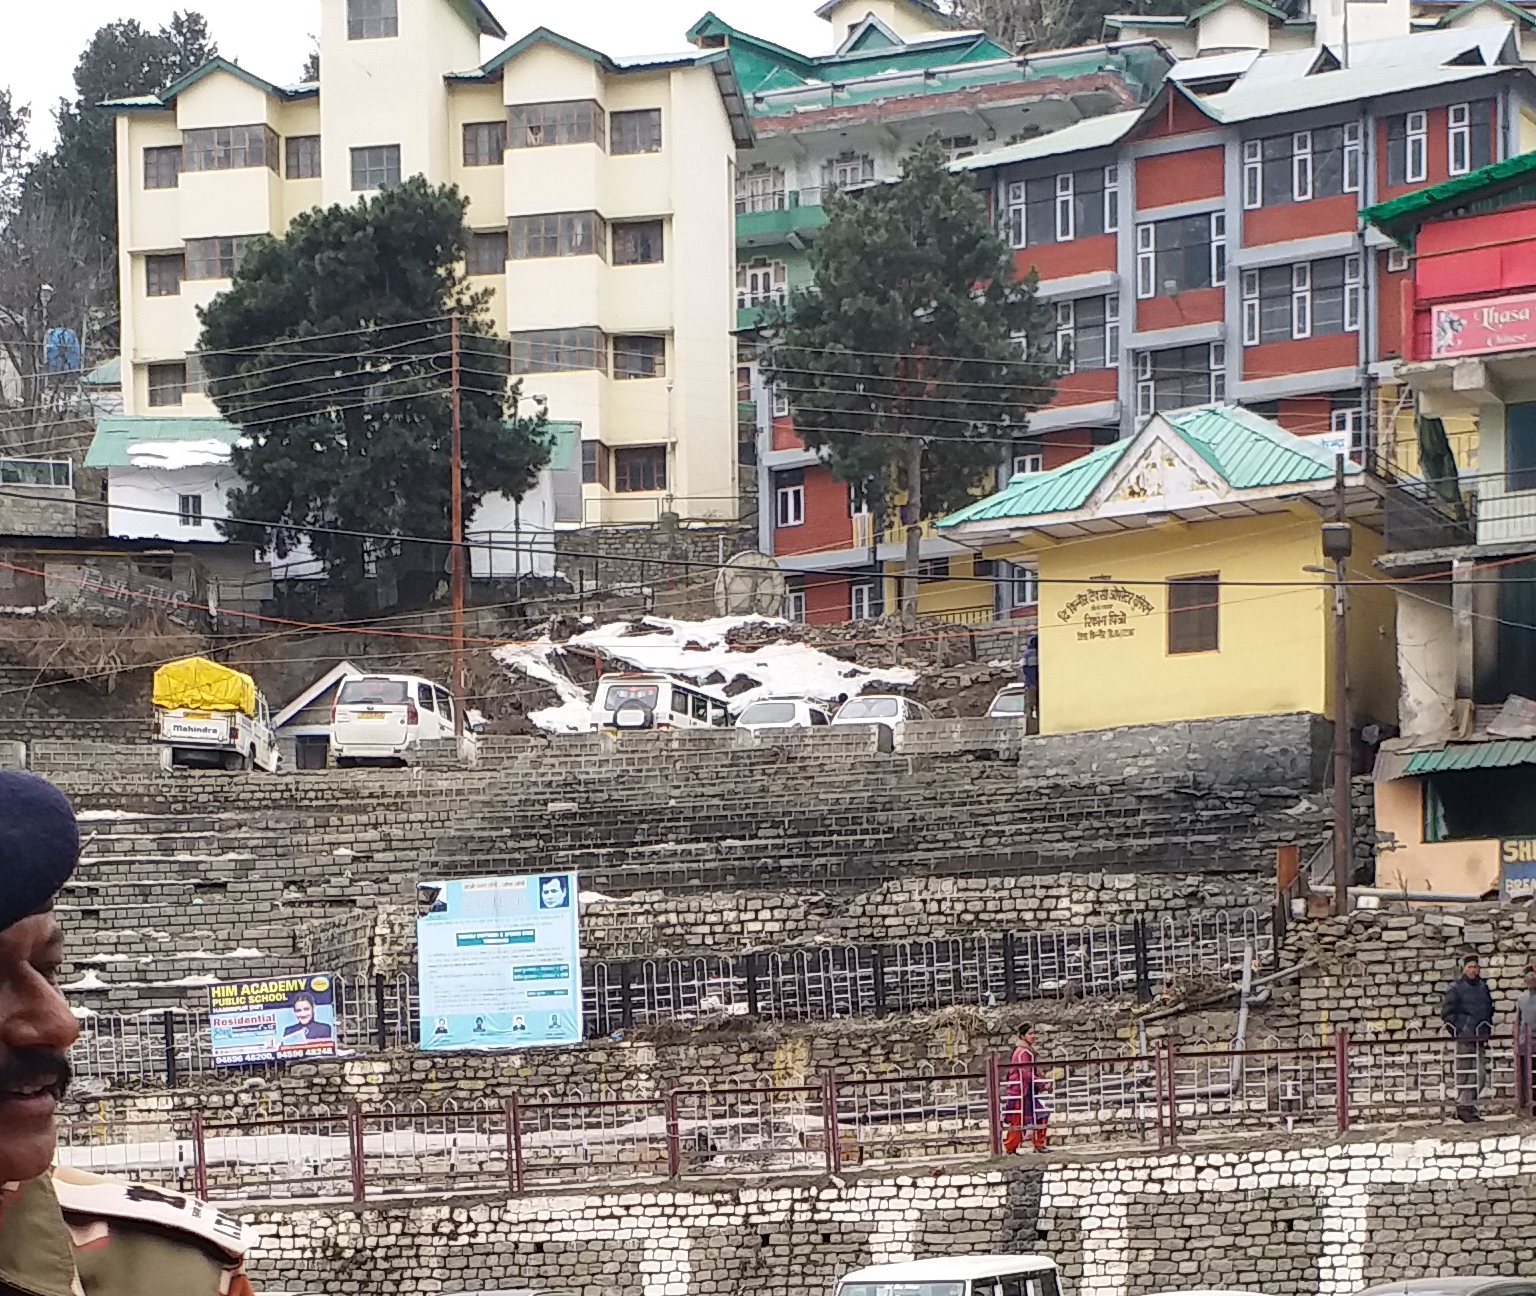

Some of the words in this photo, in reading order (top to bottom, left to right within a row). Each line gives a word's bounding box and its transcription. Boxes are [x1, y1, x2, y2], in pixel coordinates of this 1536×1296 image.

[1474, 307, 1530, 331] Lhasa
[173, 724, 218, 734] Mahindra
[211, 984, 238, 998] HIM
[240, 978, 308, 995] ACADEMY
[212, 996, 246, 1007] PUBLIC
[248, 993, 288, 1004] SCHOOL
[213, 1013, 276, 1027] Residential
